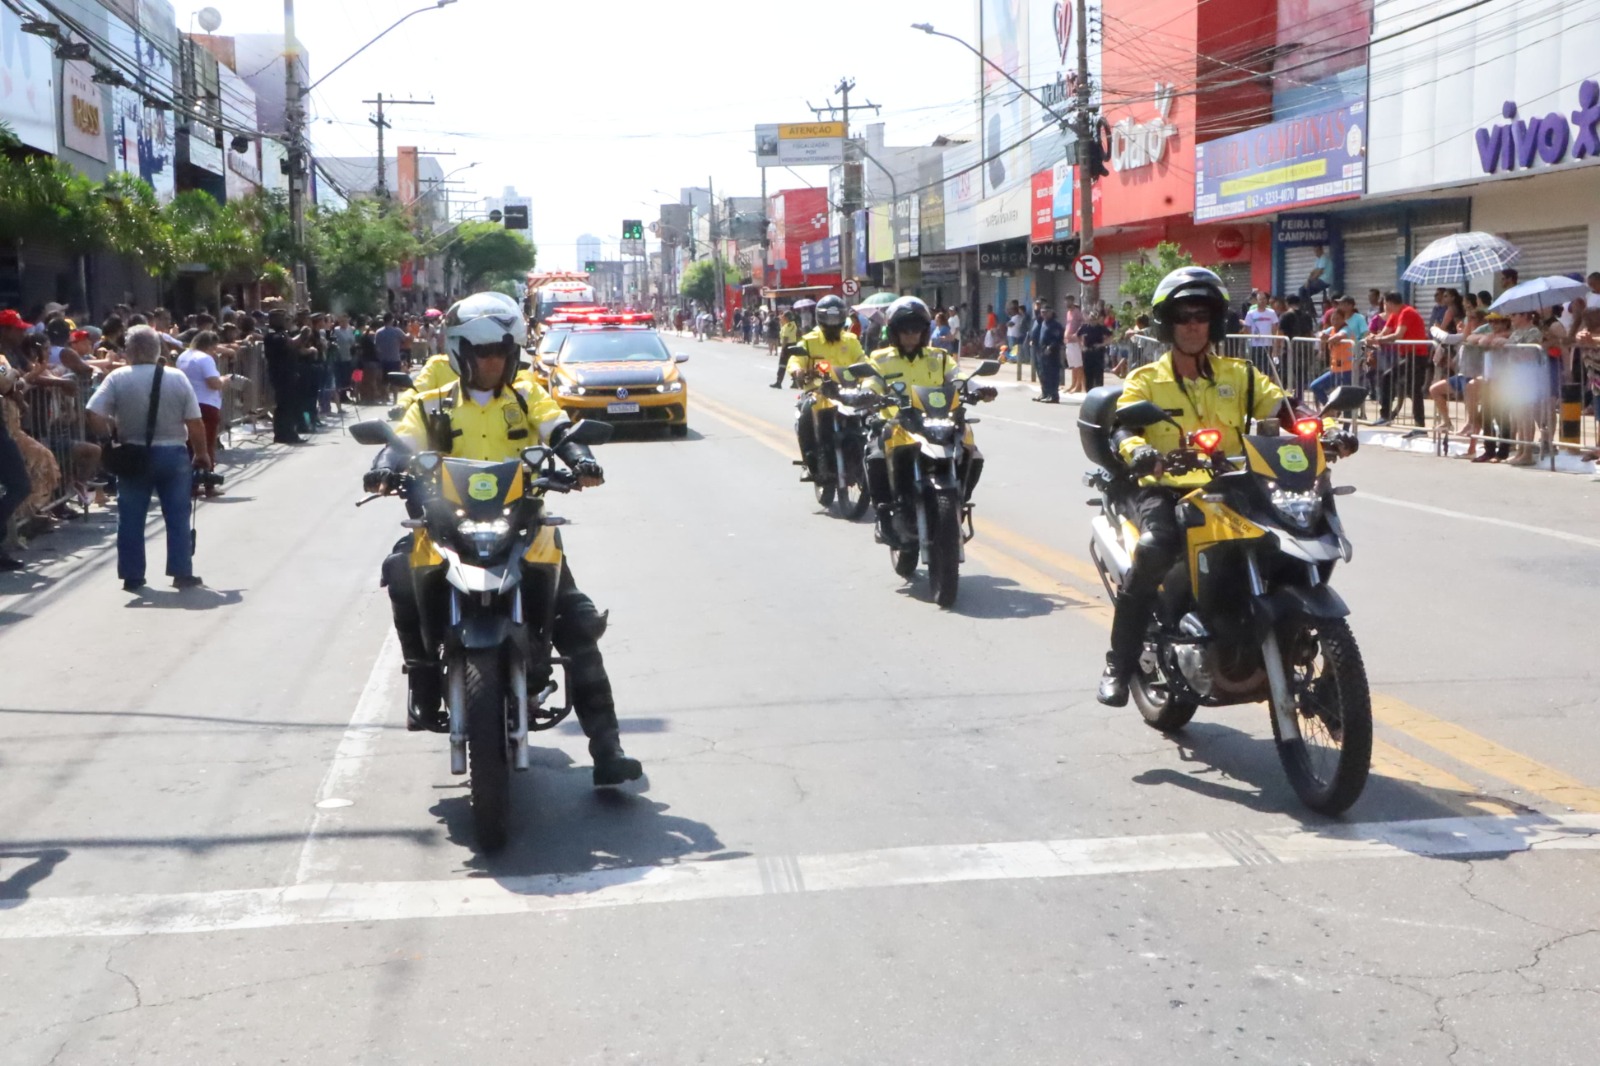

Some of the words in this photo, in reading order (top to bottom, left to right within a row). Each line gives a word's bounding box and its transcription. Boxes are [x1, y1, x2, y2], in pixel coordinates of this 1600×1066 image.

[788, 125, 832, 136] ATENÇÃO
[1475, 101, 1570, 174] vivo
[1208, 141, 1249, 179] FEIRA
[1254, 110, 1346, 167] CAMPINAS
[1281, 219, 1310, 229] FEIRA
[1312, 218, 1325, 229] DE
[1278, 231, 1328, 242] CAMPINAS
[1031, 244, 1076, 256] OMEG
